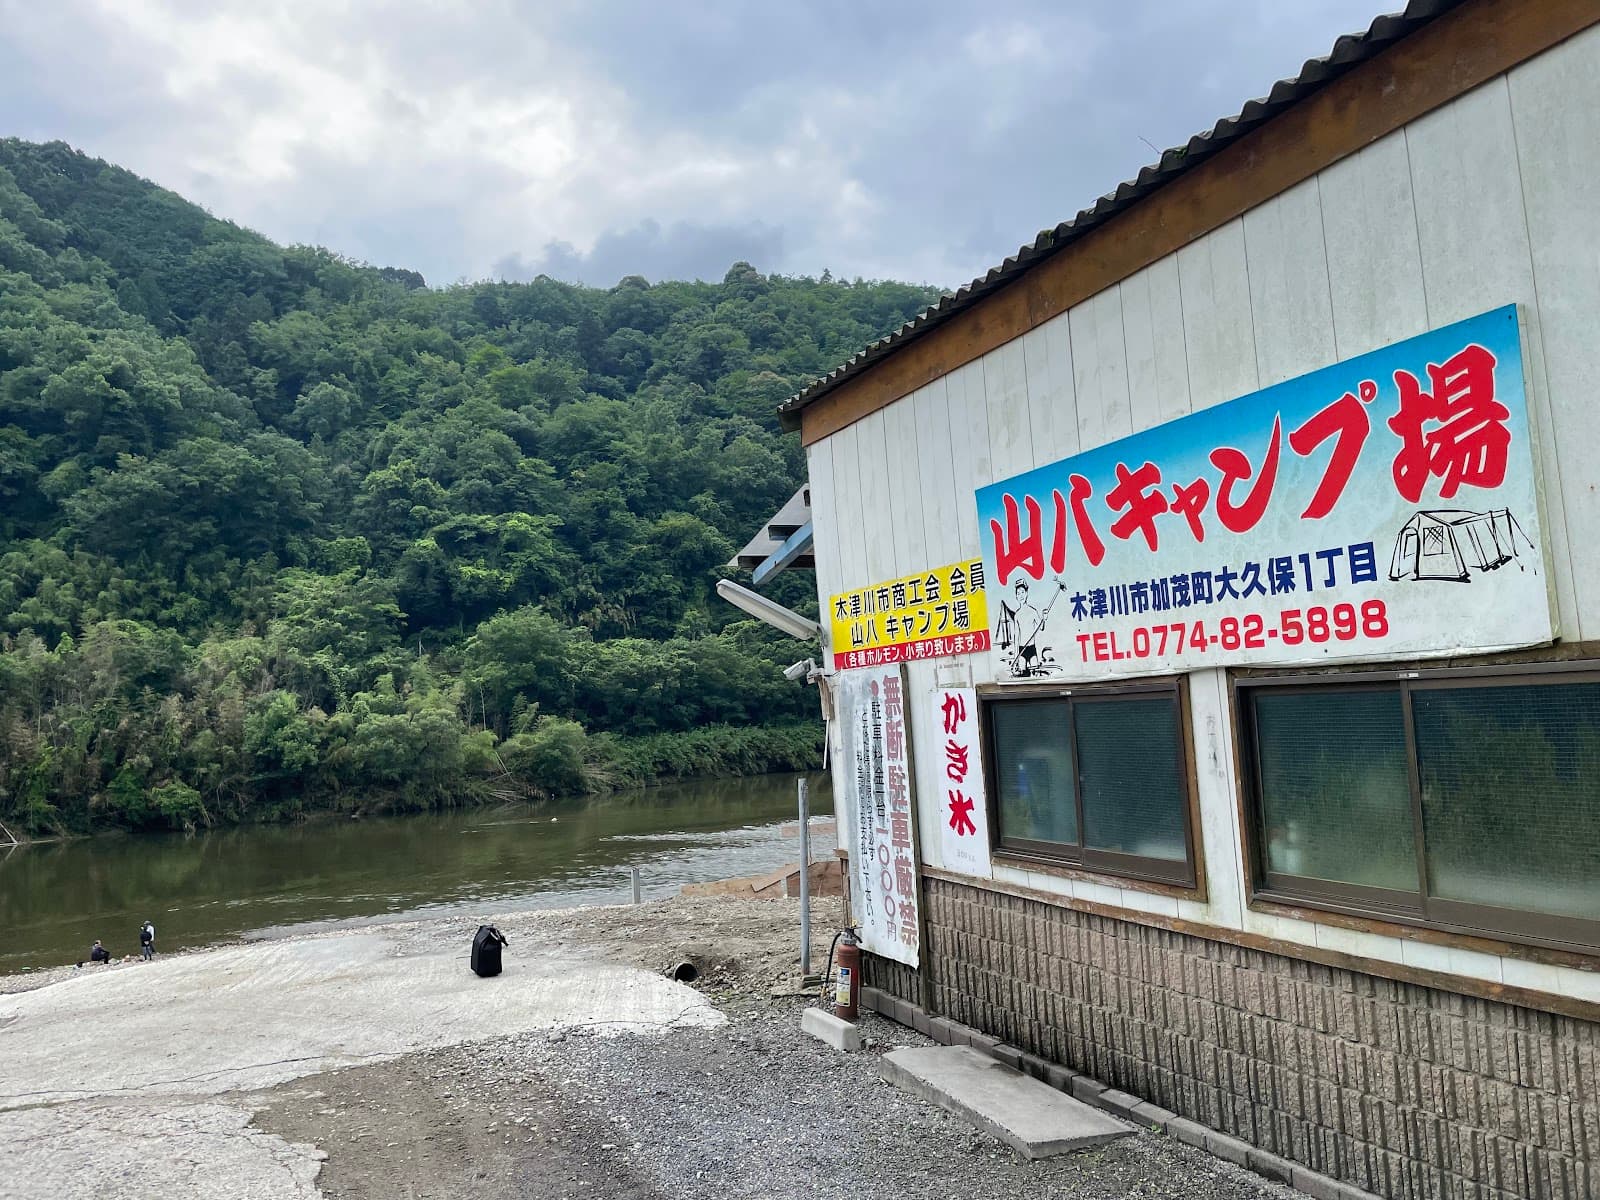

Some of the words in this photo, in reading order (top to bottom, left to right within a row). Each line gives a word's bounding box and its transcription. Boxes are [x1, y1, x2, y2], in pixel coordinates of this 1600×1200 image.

[835, 574, 940, 620] 木津川市商工会
[949, 562, 986, 597] 会員
[1070, 541, 1378, 620] 木津川市加茂町大久保1丁目
[886, 599, 970, 641] キャンプ場
[1075, 599, 1389, 662] TEL.0774-82-5898
[941, 692, 976, 836] かき氷
[883, 674, 918, 946] 無断駐車厳禁
